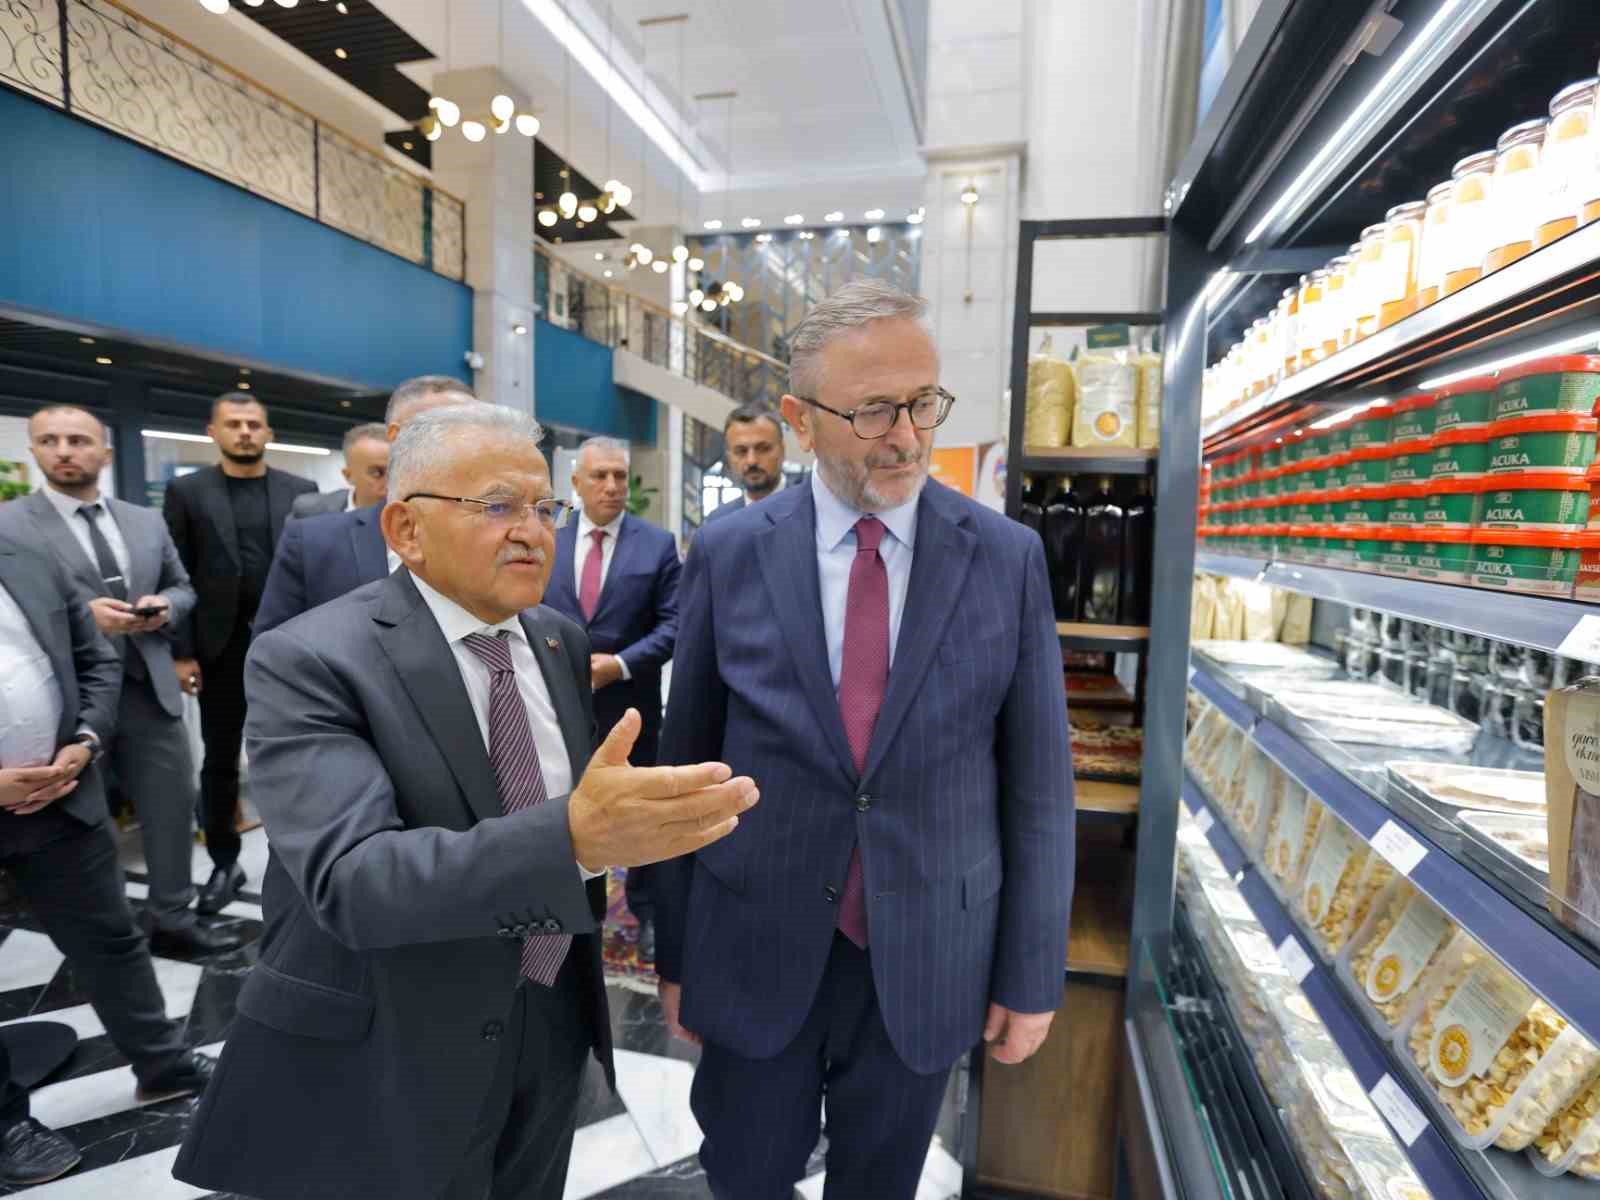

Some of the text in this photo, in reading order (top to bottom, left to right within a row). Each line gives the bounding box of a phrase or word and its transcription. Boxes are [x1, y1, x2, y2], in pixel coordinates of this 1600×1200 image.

[1491, 453, 1530, 466] ACUKA
[1486, 508, 1524, 521] ACUKA
[1475, 562, 1514, 575] ACUKA
